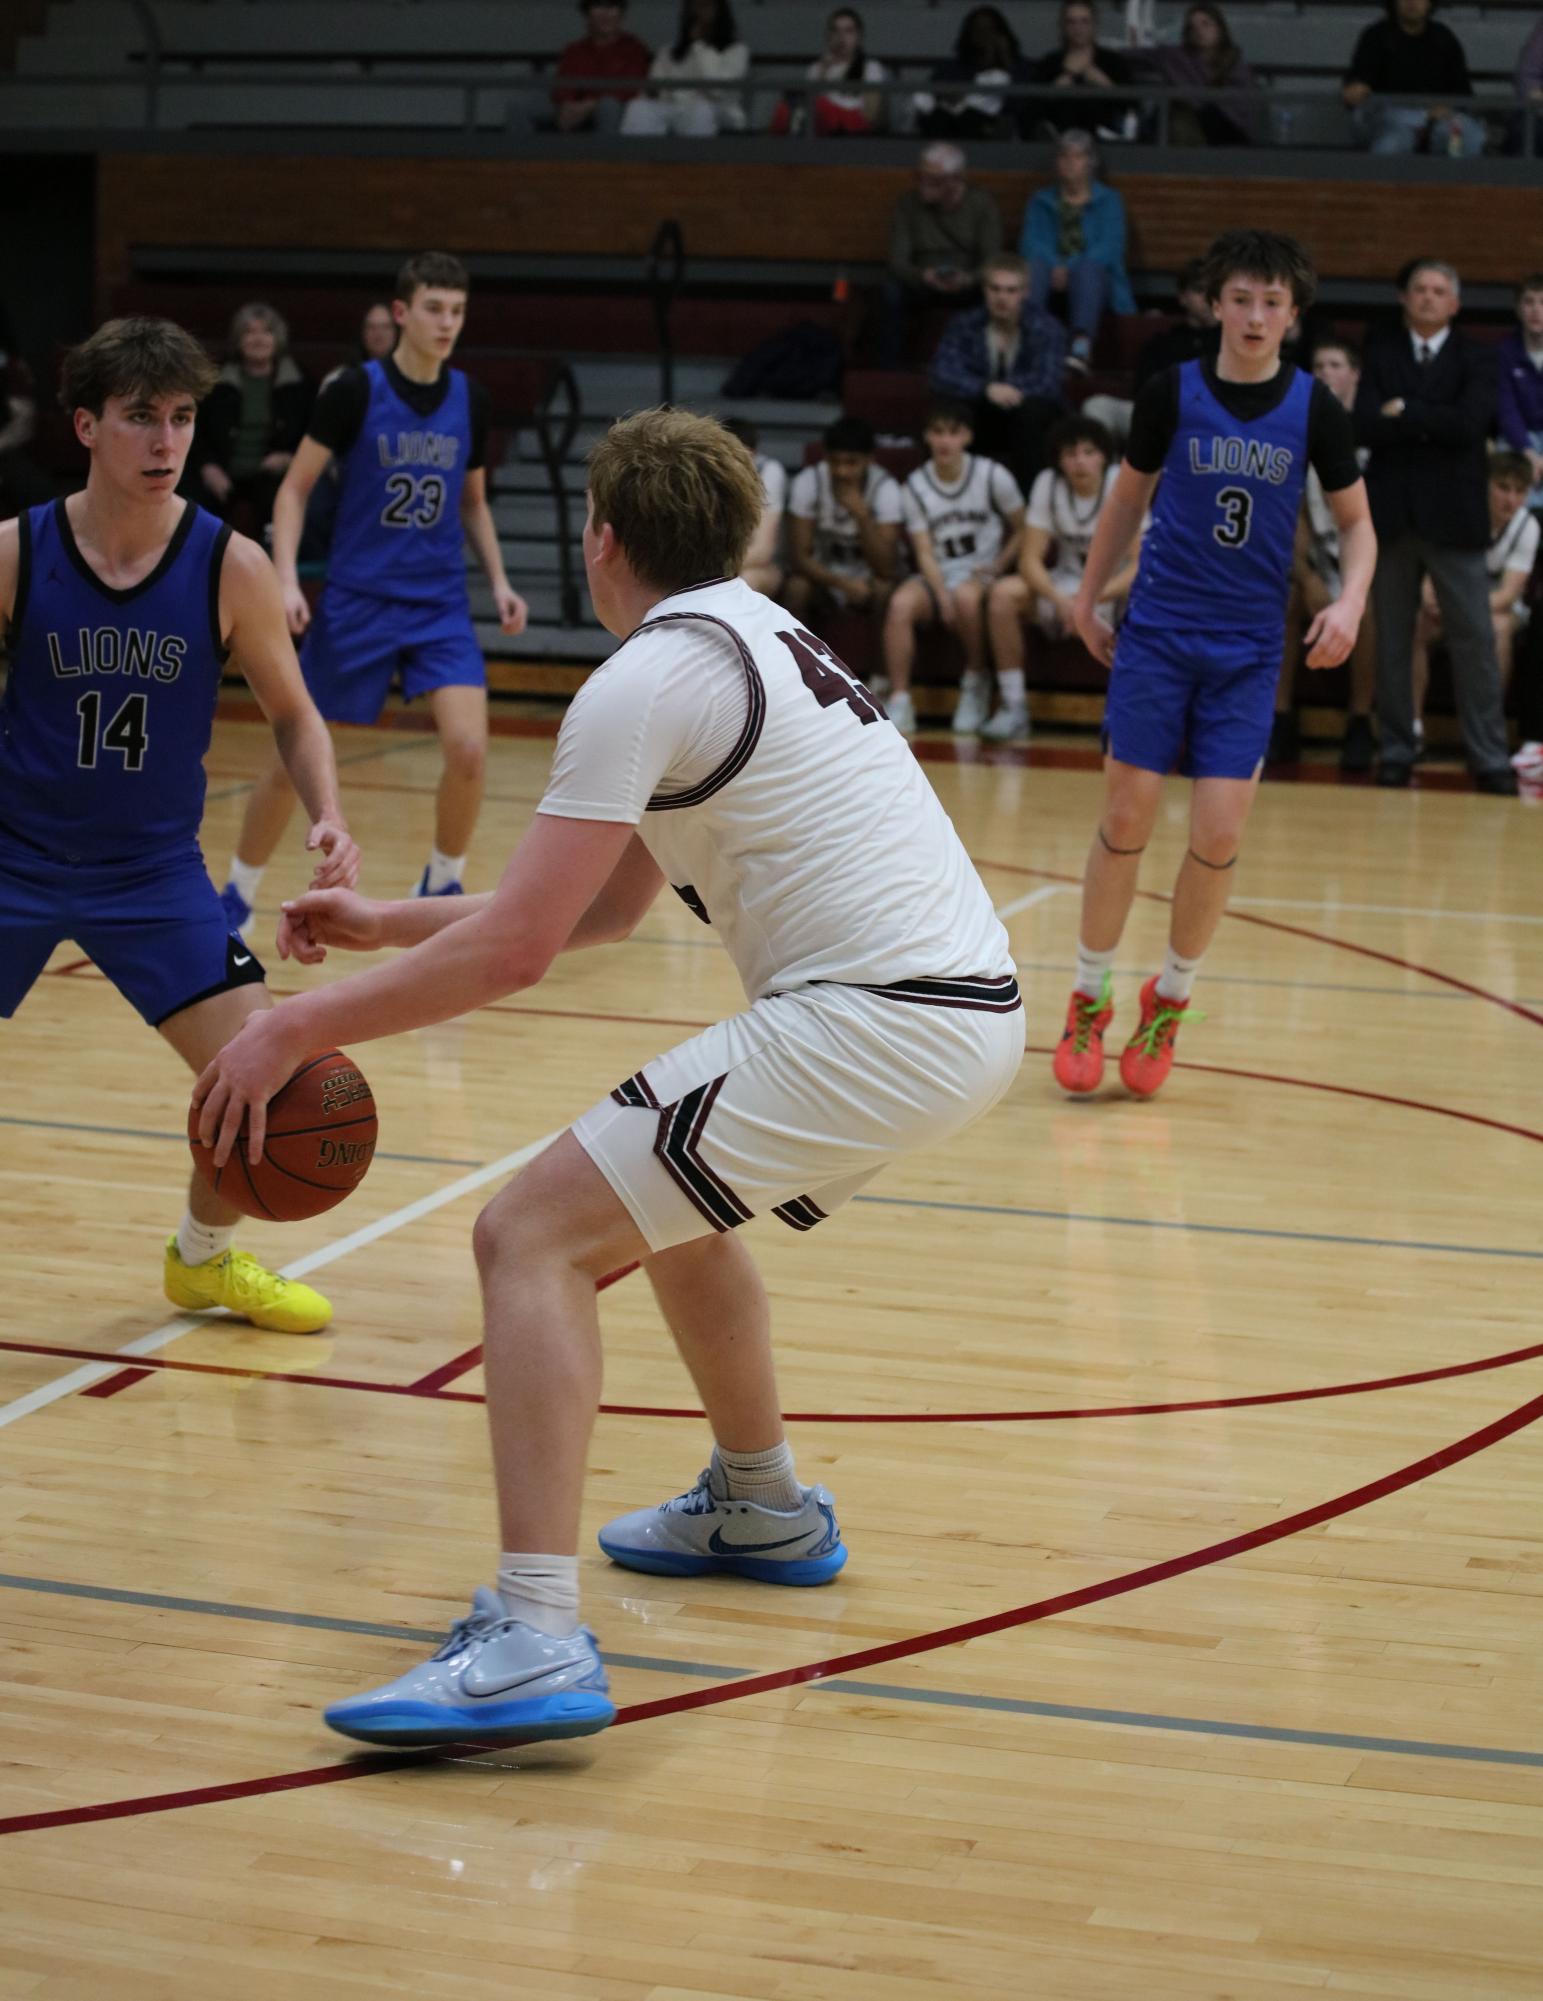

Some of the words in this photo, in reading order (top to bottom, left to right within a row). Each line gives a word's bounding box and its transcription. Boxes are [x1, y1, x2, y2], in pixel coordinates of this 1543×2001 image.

[377, 431, 459, 470] LIONS
[1189, 436, 1293, 484] LIONS
[381, 472, 447, 528] 23
[1213, 485, 1253, 549] 3
[47, 626, 187, 683] LIONS
[76, 690, 148, 771] 14
